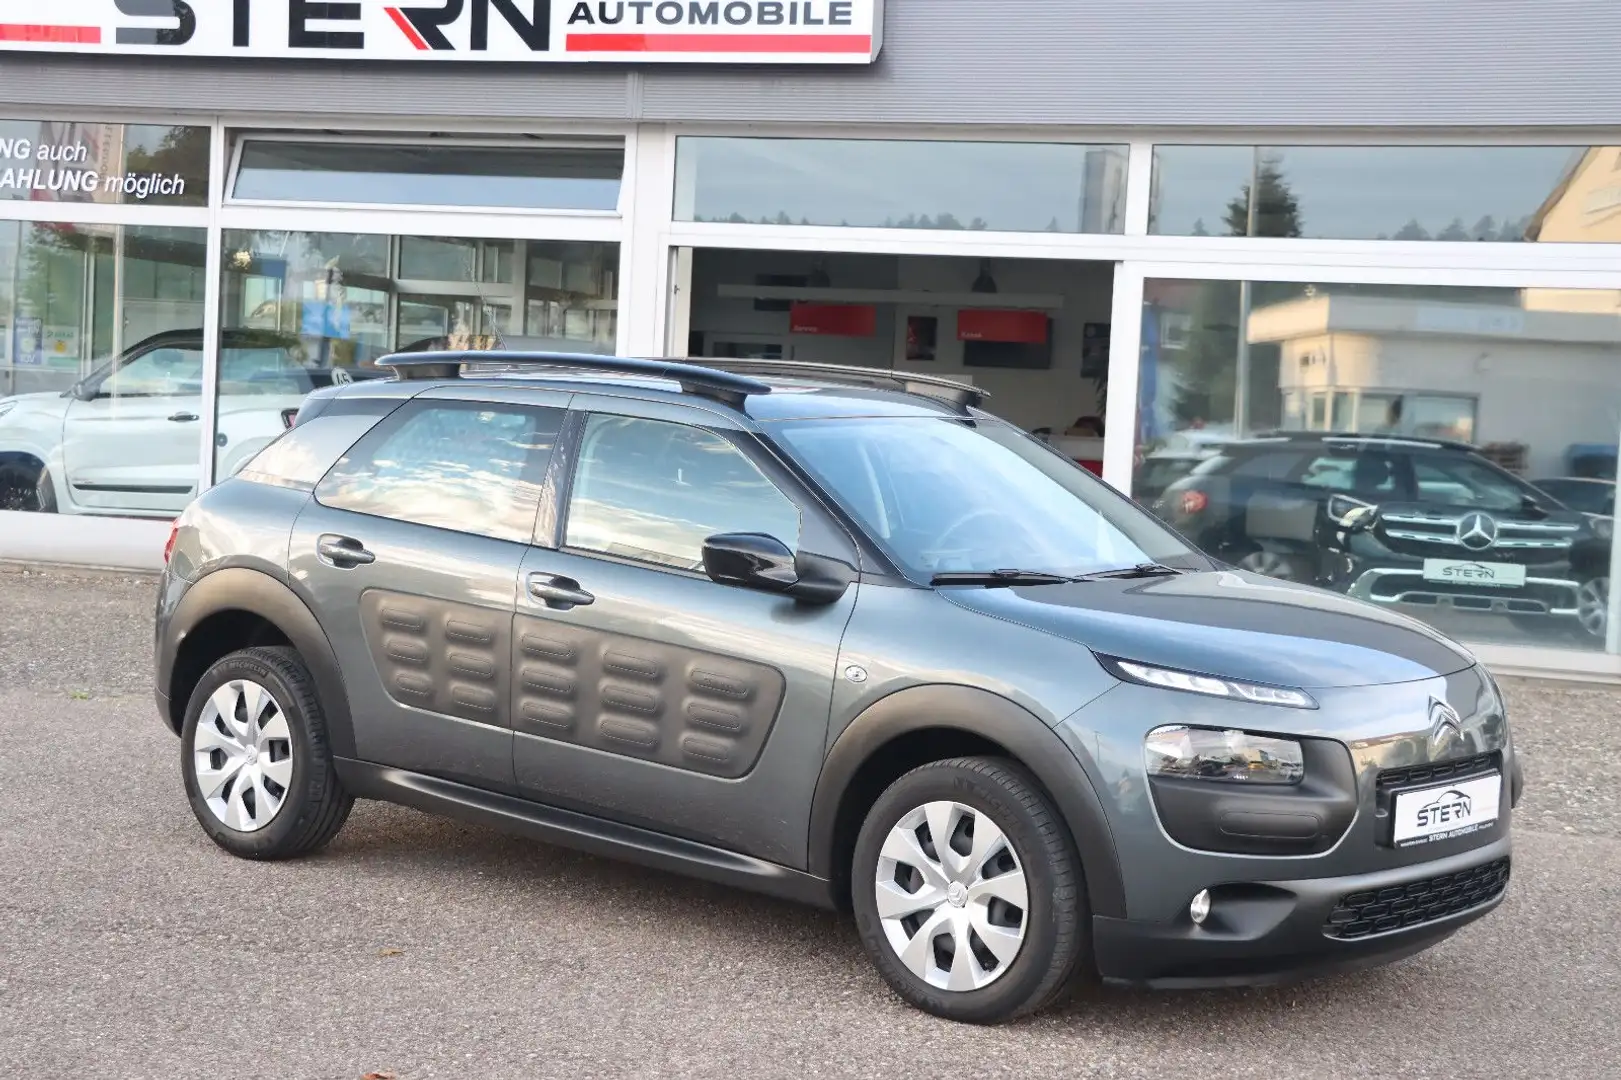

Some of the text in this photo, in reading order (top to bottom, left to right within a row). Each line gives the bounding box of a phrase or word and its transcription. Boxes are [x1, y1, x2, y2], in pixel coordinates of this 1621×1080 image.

[566, 1, 852, 25] AUTOMOBILE
[36, 141, 87, 162] auch
[104, 173, 185, 199] möglich
[1442, 567, 1495, 579] STERN
[1417, 801, 1471, 827] STERN
[1429, 832, 1448, 842] STERN
